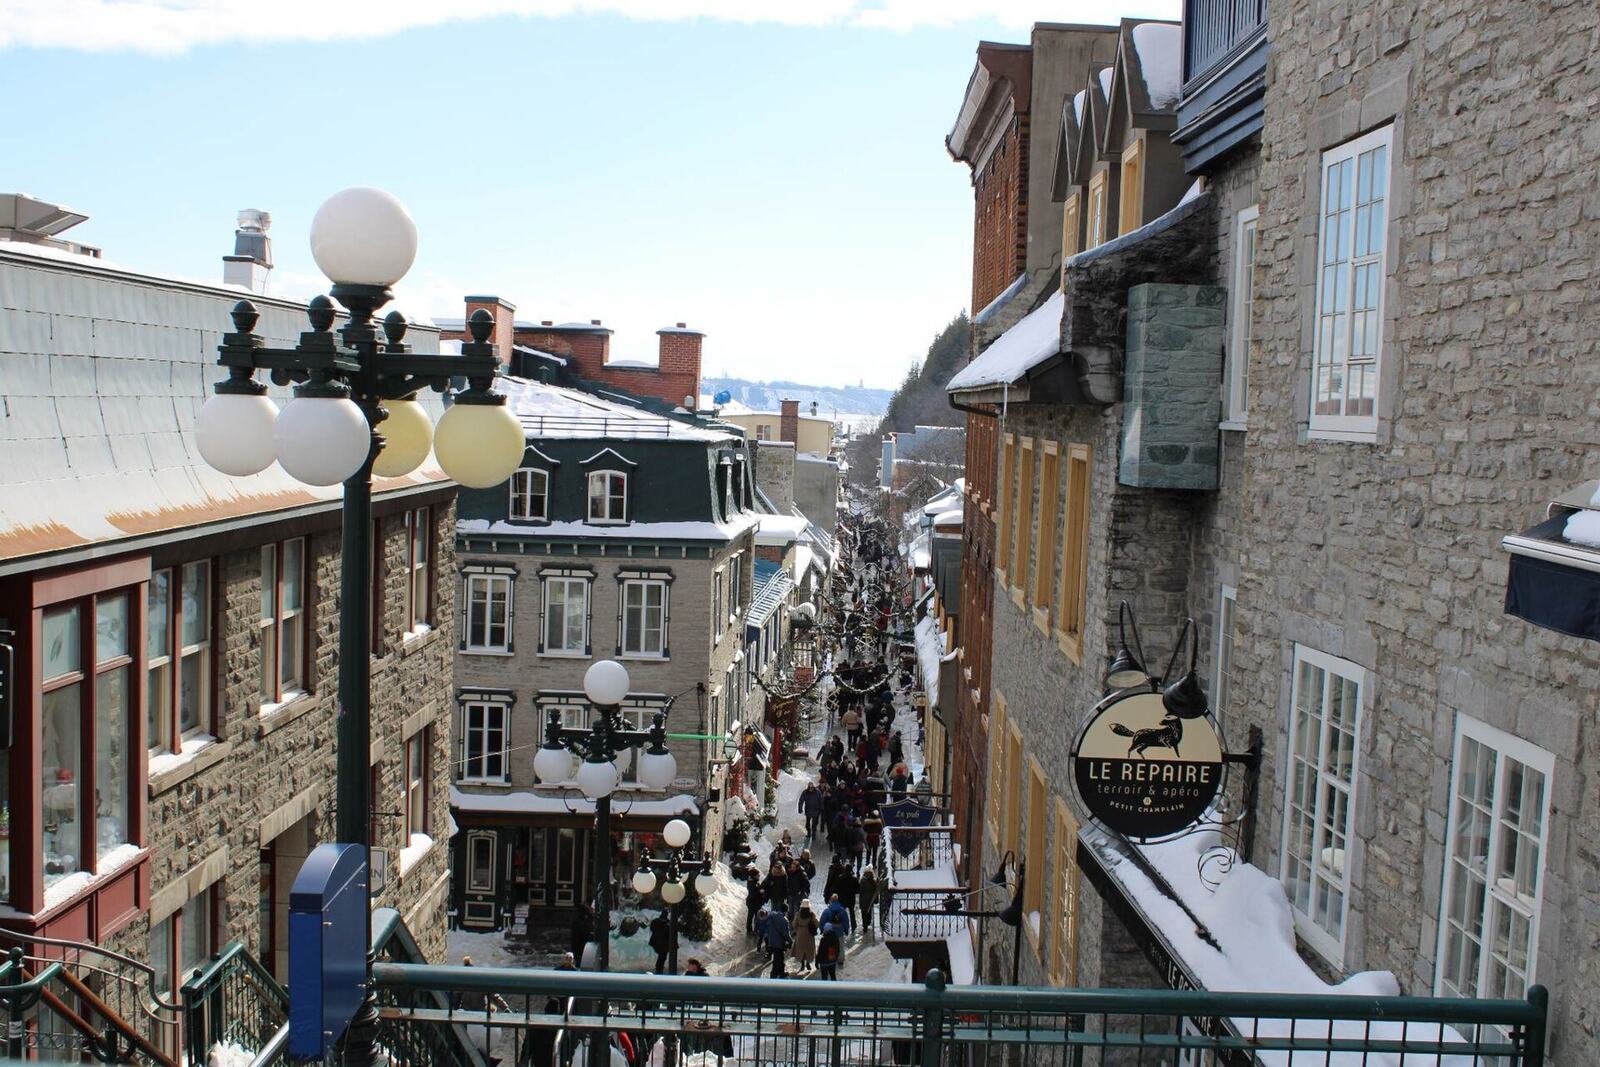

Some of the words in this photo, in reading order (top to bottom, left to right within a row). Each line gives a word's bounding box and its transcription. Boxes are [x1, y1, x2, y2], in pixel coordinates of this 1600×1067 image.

[1089, 762, 1111, 779] LE
[1121, 763, 1210, 783] REPAIRE
[1097, 784, 1141, 794] terroir
[1149, 785, 1155, 796] &
[1162, 785, 1199, 798] apéro
[1109, 801, 1133, 811] PETIT
[1137, 804, 1185, 813] CHAMPLAIN
